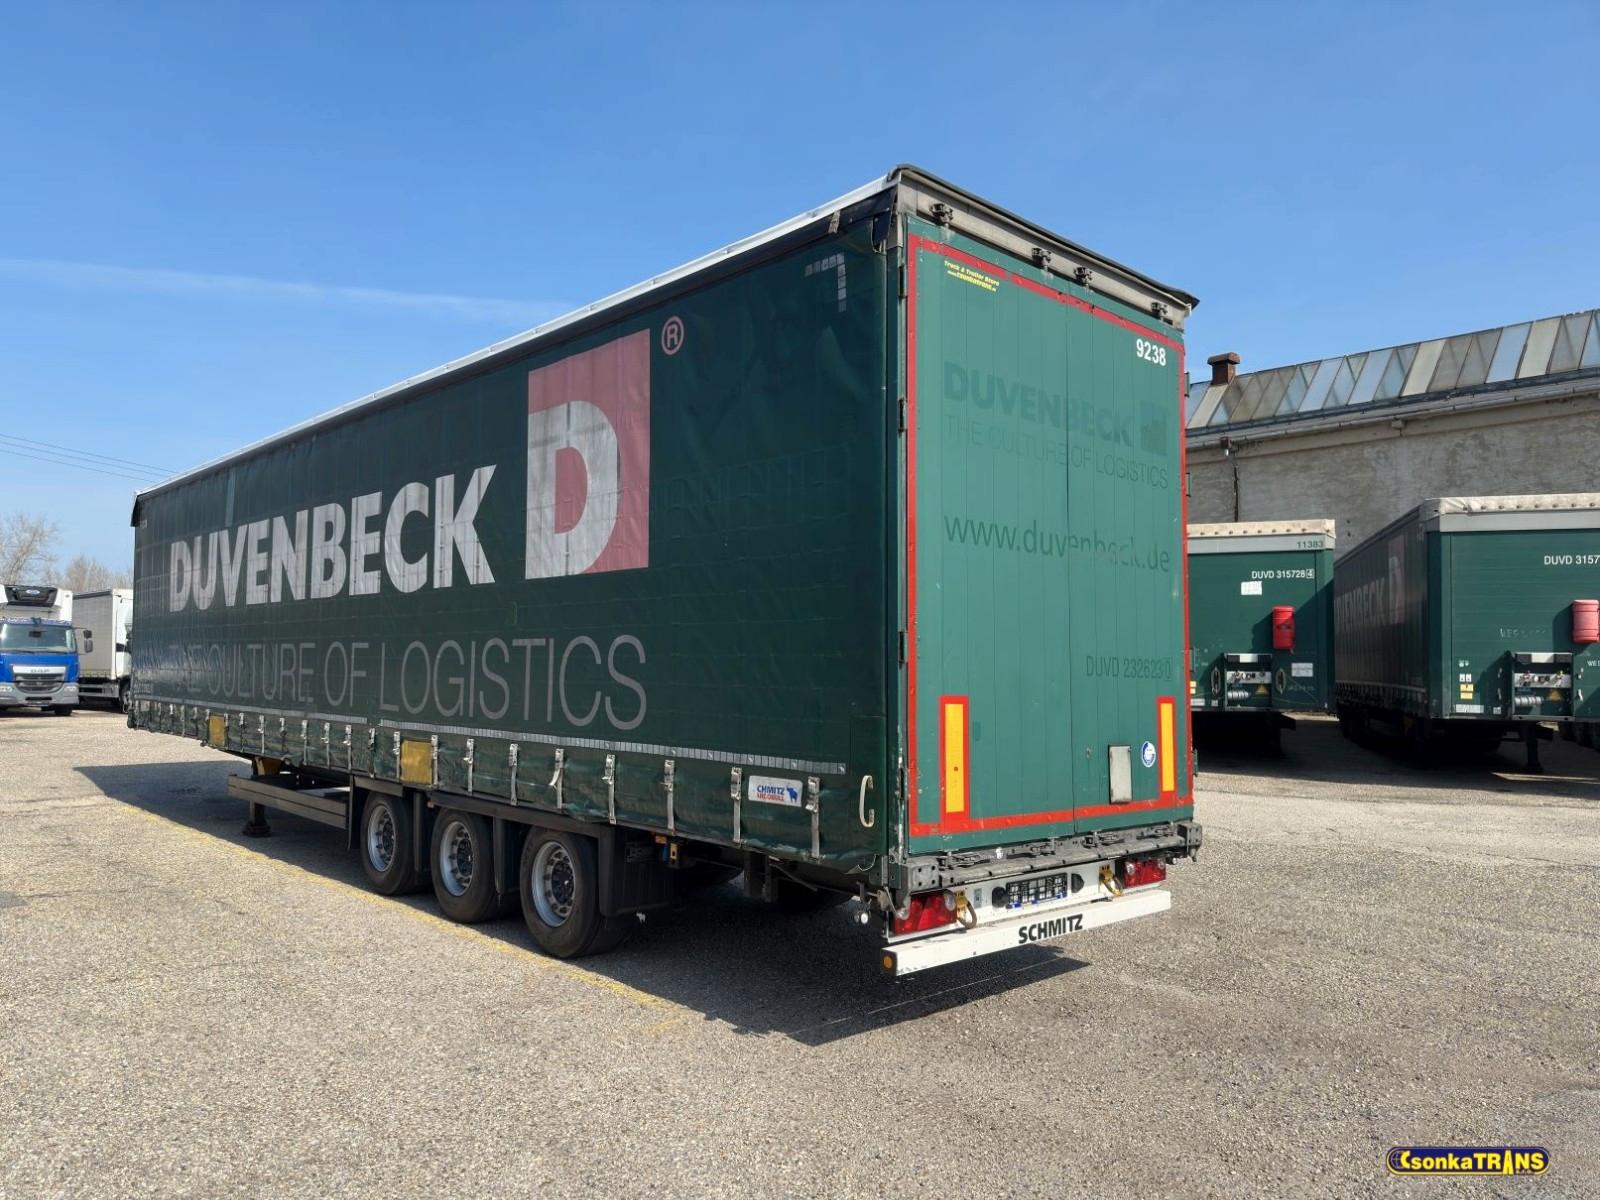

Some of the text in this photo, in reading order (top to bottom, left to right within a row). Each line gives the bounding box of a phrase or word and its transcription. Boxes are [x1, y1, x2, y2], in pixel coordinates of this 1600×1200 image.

[1136, 338, 1166, 366] 9238
[944, 361, 1133, 447] DUVENBECK
[1071, 446, 1092, 470] OF
[1095, 452, 1168, 489] LOGISTICS
[525, 400, 620, 580] D
[169, 465, 497, 613] DUVENBECK
[1251, 570, 1275, 579] DUVD
[1544, 555, 1573, 565] DUVD
[1086, 655, 1119, 678] DUVD
[207, 642, 316, 703] CULTURE
[323, 641, 369, 707] OF
[379, 634, 648, 731] LOGISTICS
[755, 784, 785, 796] CHMITZ
[1018, 914, 1083, 944] SCHMITZ
